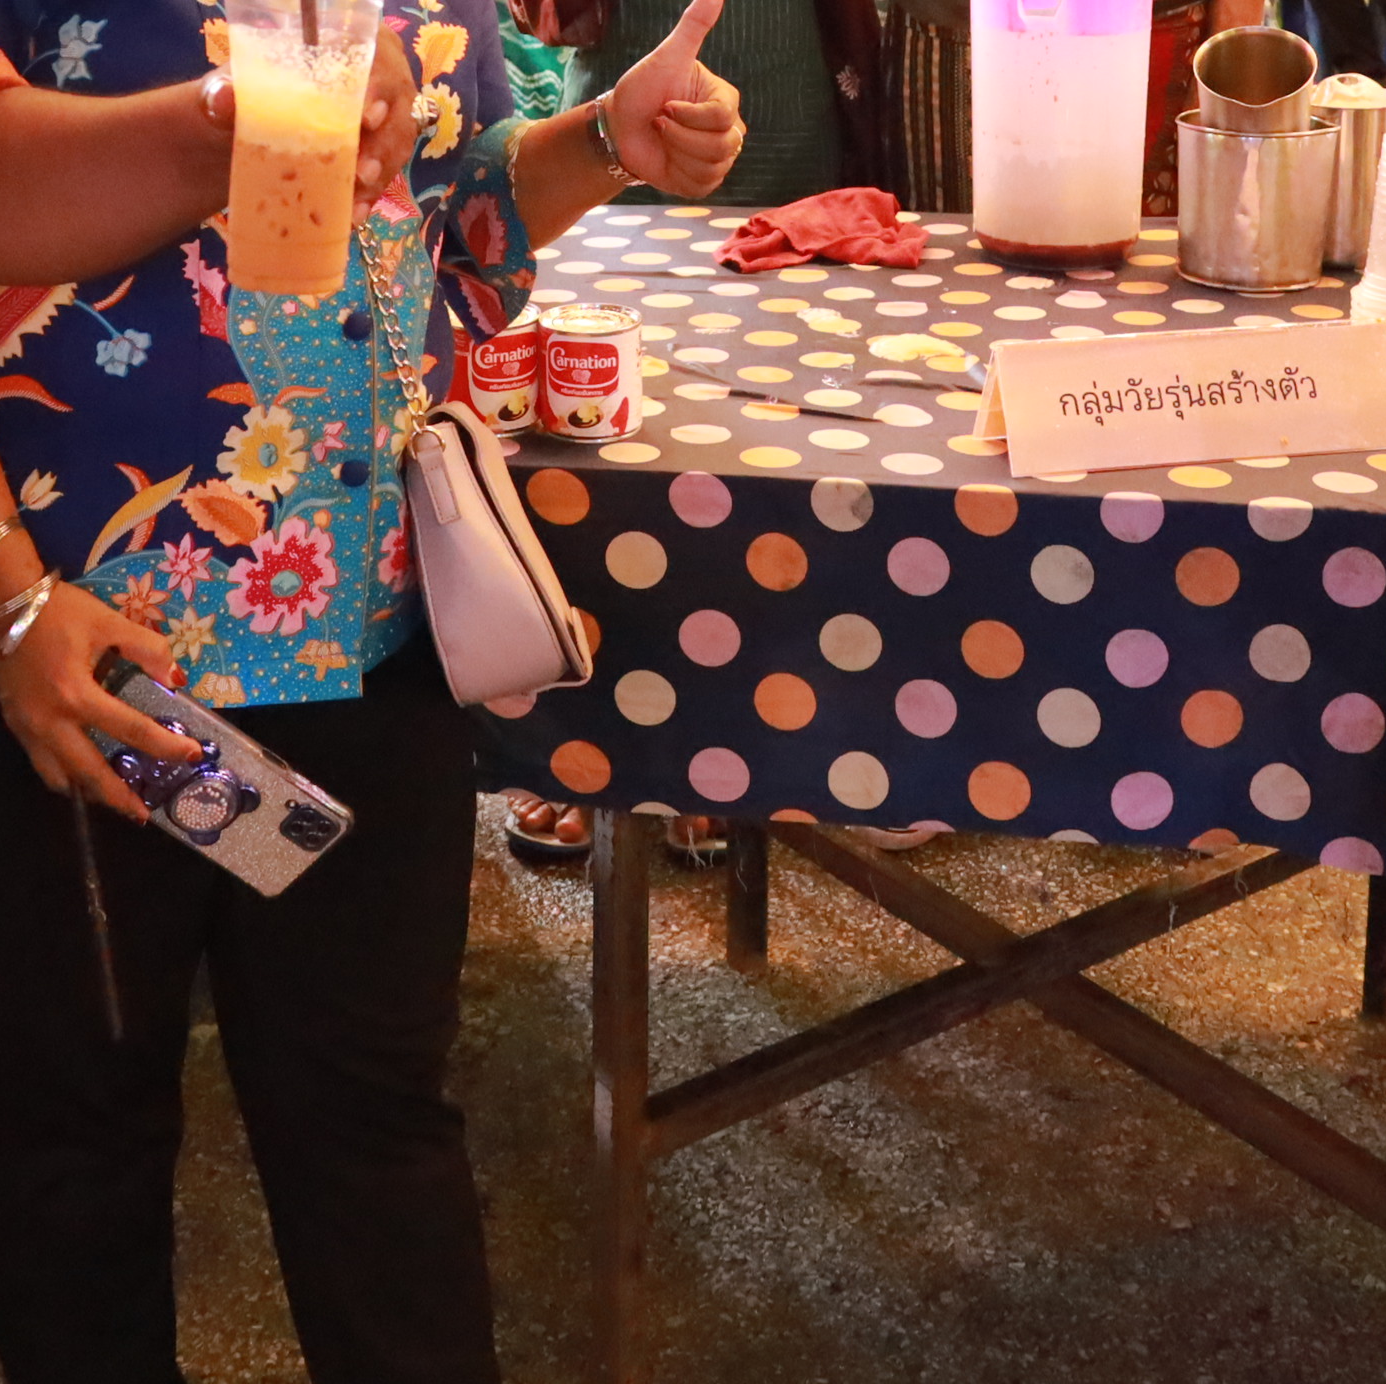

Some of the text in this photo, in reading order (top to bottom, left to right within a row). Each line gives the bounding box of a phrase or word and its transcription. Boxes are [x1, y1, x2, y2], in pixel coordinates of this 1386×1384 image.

[474, 344, 536, 369] Carnation
[550, 347, 617, 371] Carnation
[1059, 366, 1318, 426] กลุ่มวัยรุ่นสร้างตัว
